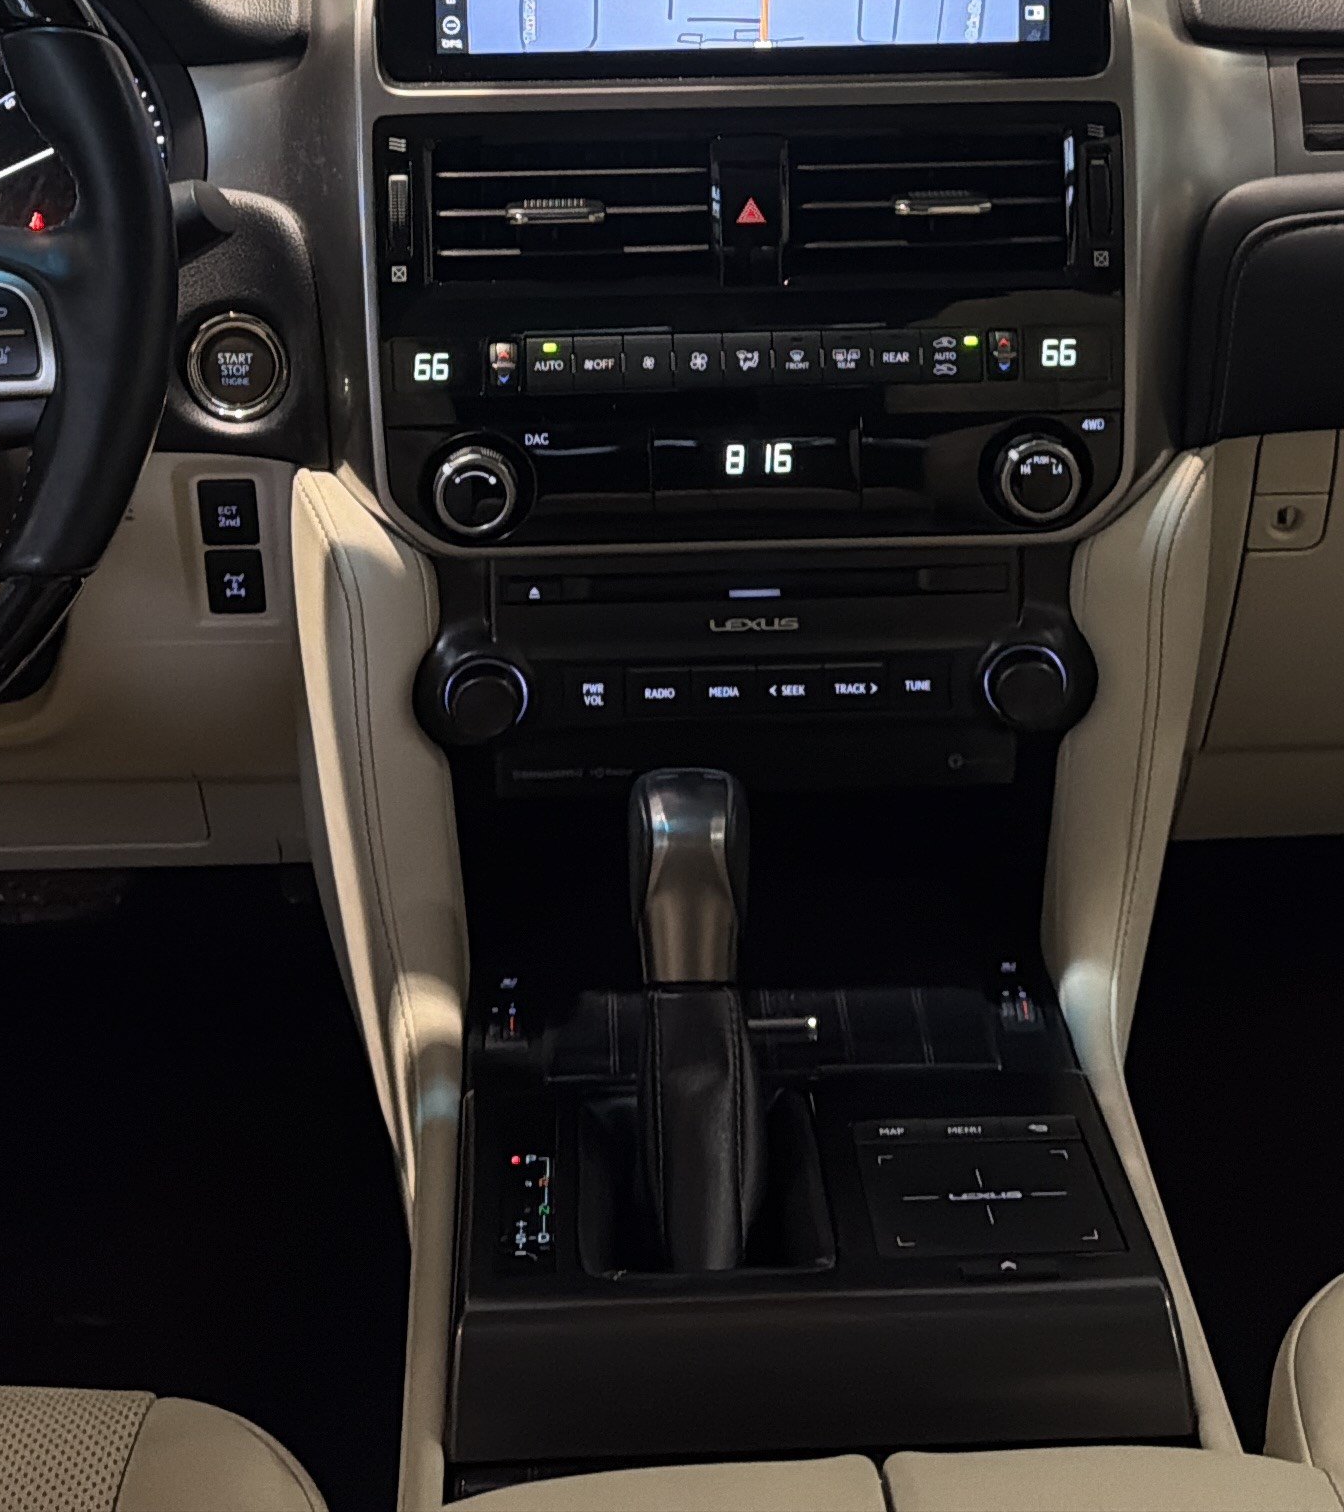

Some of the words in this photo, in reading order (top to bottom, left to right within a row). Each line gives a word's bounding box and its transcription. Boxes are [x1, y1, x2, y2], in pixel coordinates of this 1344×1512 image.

[217, 352, 254, 365] START
[882, 351, 910, 364] REAR
[933, 352, 957, 362] AUTO
[1040, 337, 1077, 368] 66
[220, 364, 250, 377] STOP
[412, 351, 450, 382] 66
[533, 359, 564, 372] AUTO
[592, 357, 616, 371] OFF
[1081, 417, 1105, 431] 4WD
[524, 432, 550, 446] DAC
[217, 505, 238, 516] ECT
[217, 516, 241, 528] 2nd
[709, 617, 799, 632] LEXUS
[582, 682, 605, 695] PWR
[708, 686, 740, 698] MEDIA
[781, 683, 806, 696] SEEK
[834, 682, 867, 695] TRACK
[905, 679, 931, 692] TUNE
[644, 687, 676, 700] RADIO
[583, 694, 605, 707] VOL
[878, 1126, 905, 1136] MAP
[947, 1125, 982, 1135] MENU
